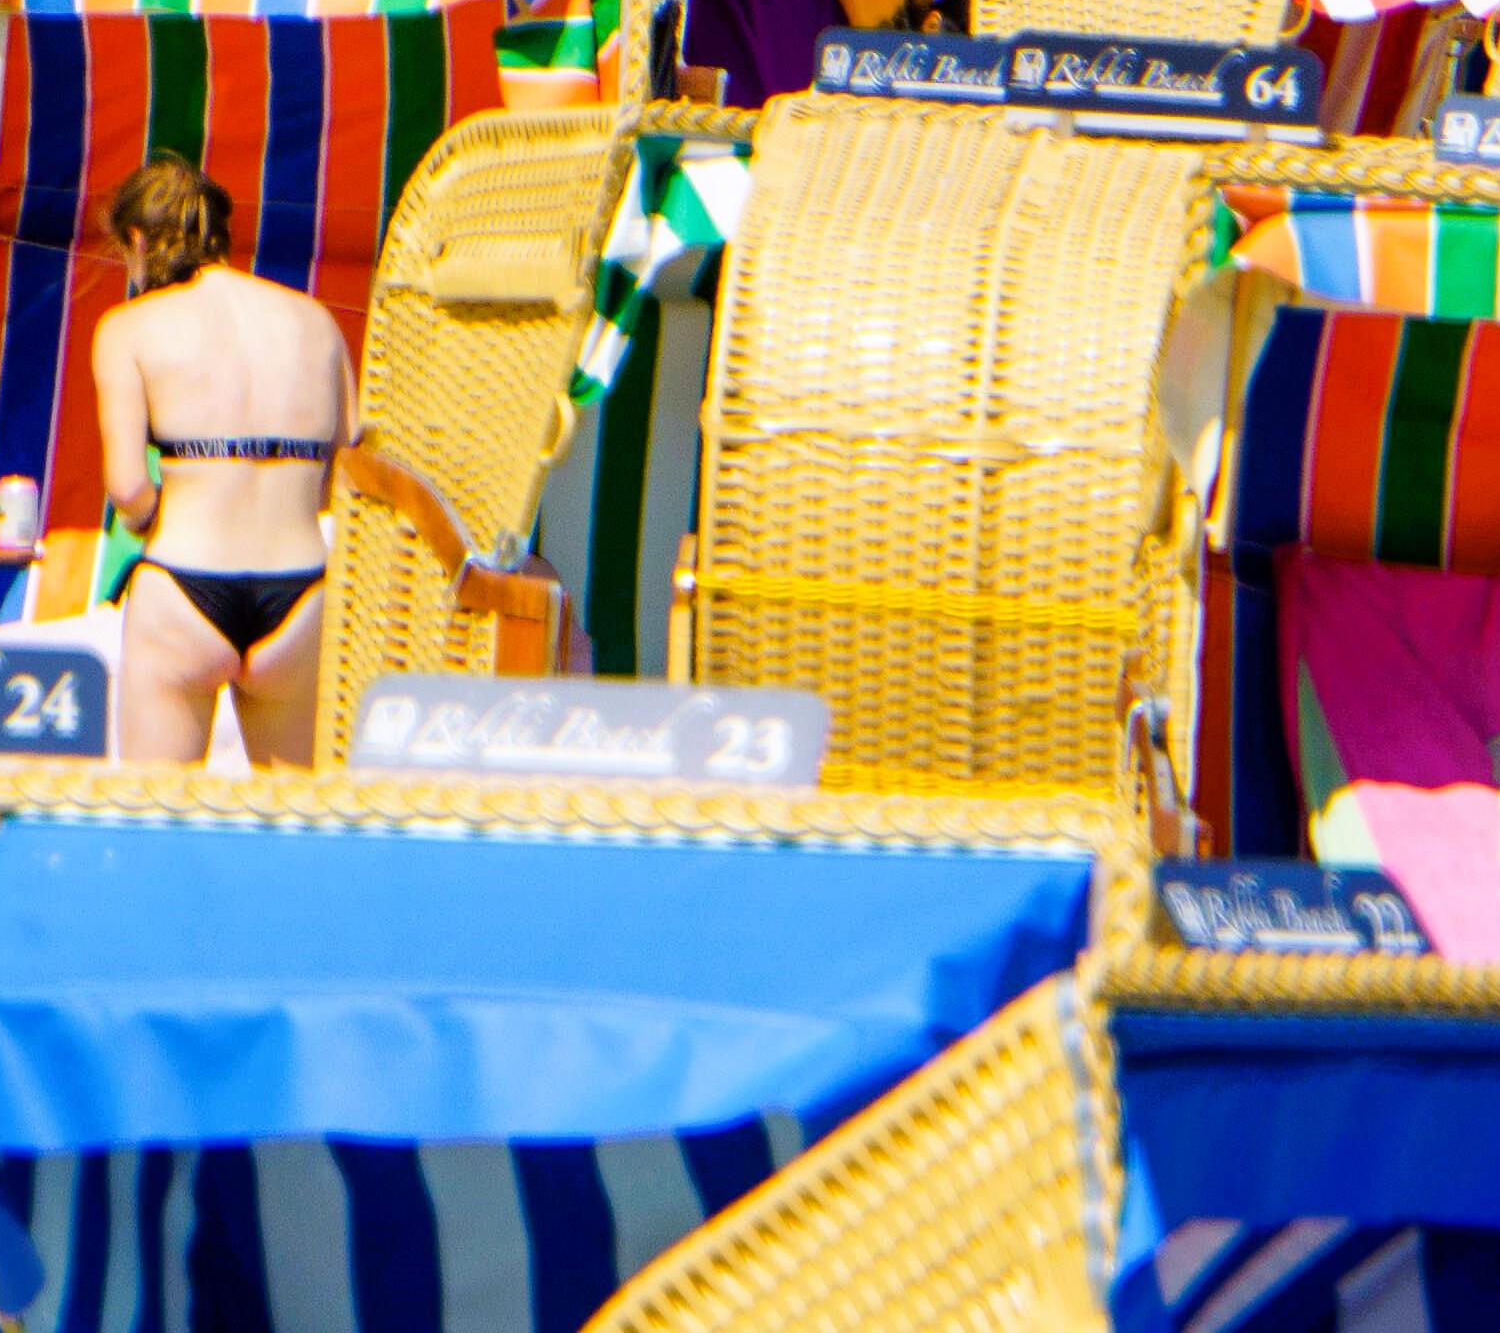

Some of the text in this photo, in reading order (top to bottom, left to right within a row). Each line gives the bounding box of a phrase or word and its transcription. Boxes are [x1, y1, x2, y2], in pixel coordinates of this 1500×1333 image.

[850, 42, 928, 93] Rikki
[1047, 46, 1302, 110] Rikki Beach 64
[3, 671, 81, 738] 24
[409, 692, 793, 781] Rikki Beach 23
[1353, 891, 1419, 952] 22
